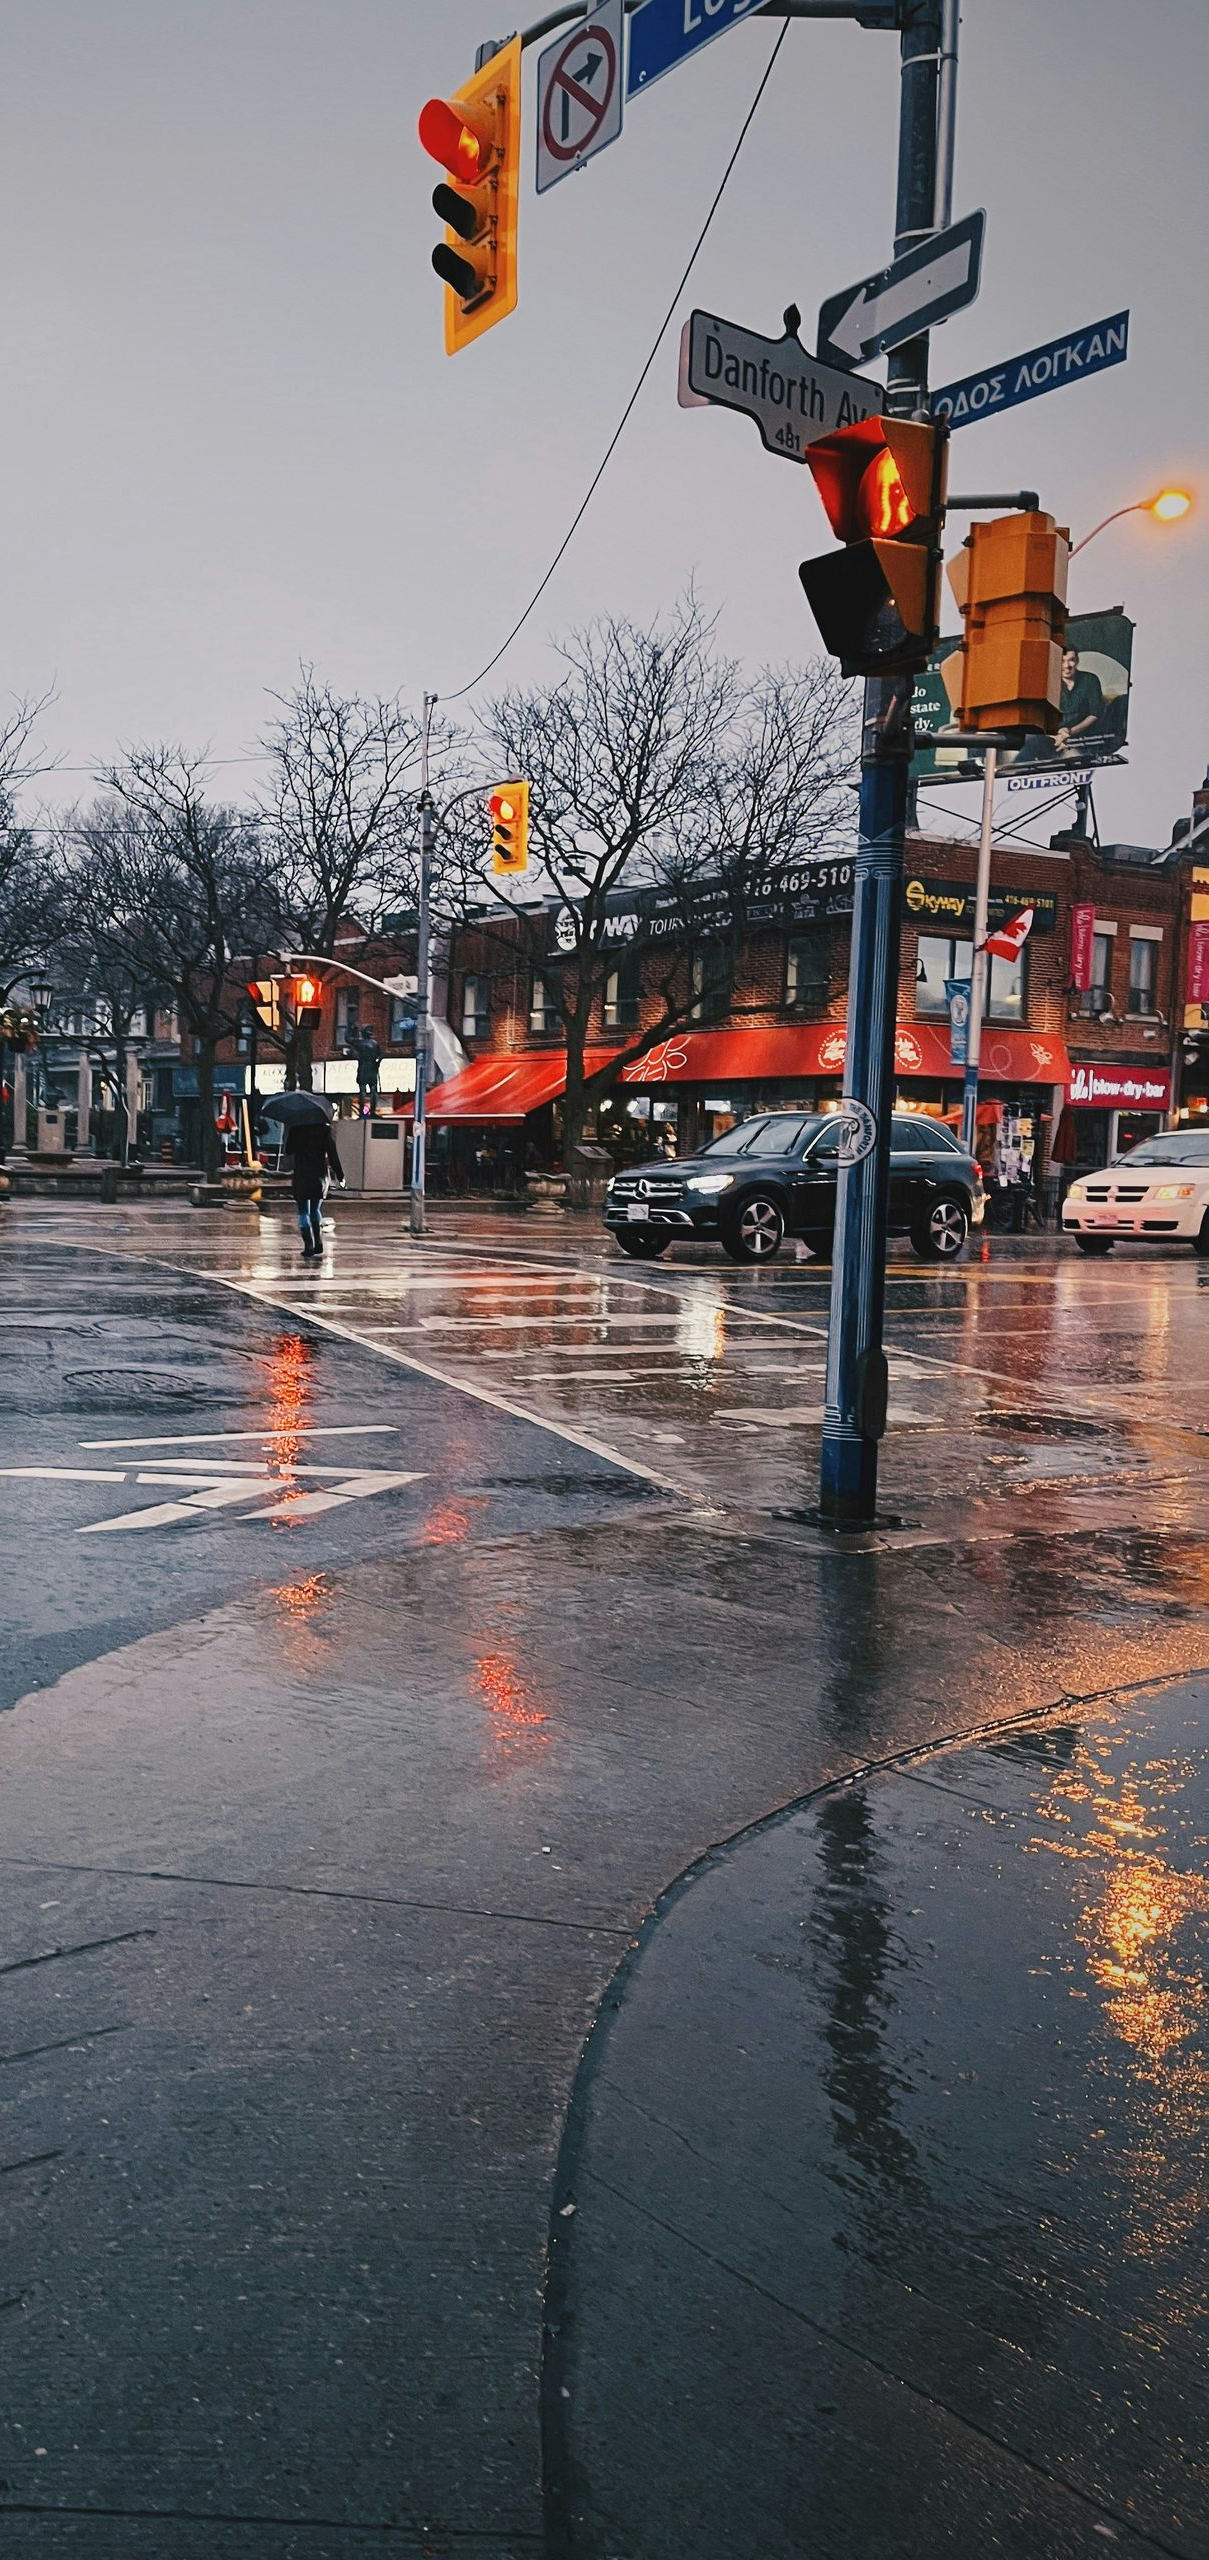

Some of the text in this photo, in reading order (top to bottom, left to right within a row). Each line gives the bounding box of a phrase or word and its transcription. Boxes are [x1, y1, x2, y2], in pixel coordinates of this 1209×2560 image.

[705, 335, 824, 422] Danforth
[1014, 324, 1126, 393] ΛΟΓΚΑΝ
[1010, 771, 1092, 790] OUTFRONT
